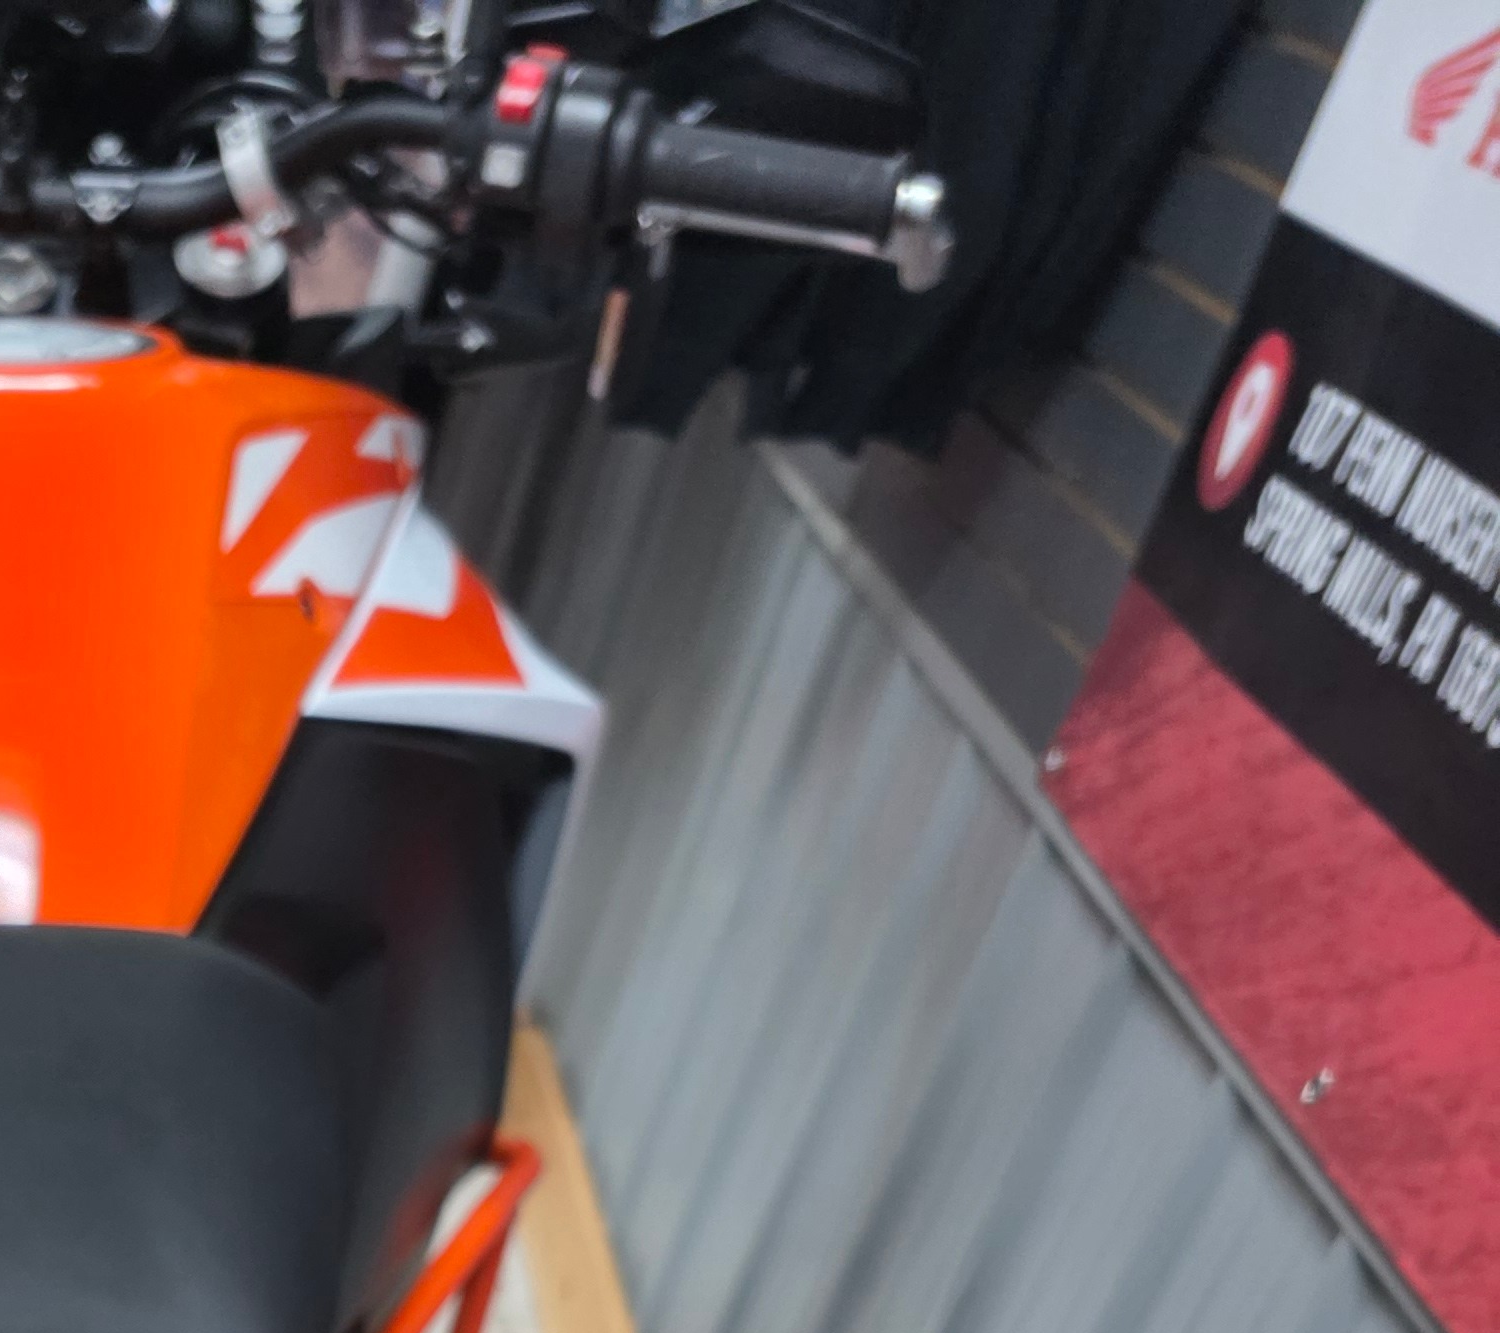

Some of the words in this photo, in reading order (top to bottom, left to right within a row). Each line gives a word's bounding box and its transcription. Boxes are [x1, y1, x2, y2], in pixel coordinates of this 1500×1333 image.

[1333, 410, 1426, 518] PENN
[1243, 475, 1352, 594] SPRING
[1398, 592, 1462, 685] PA
